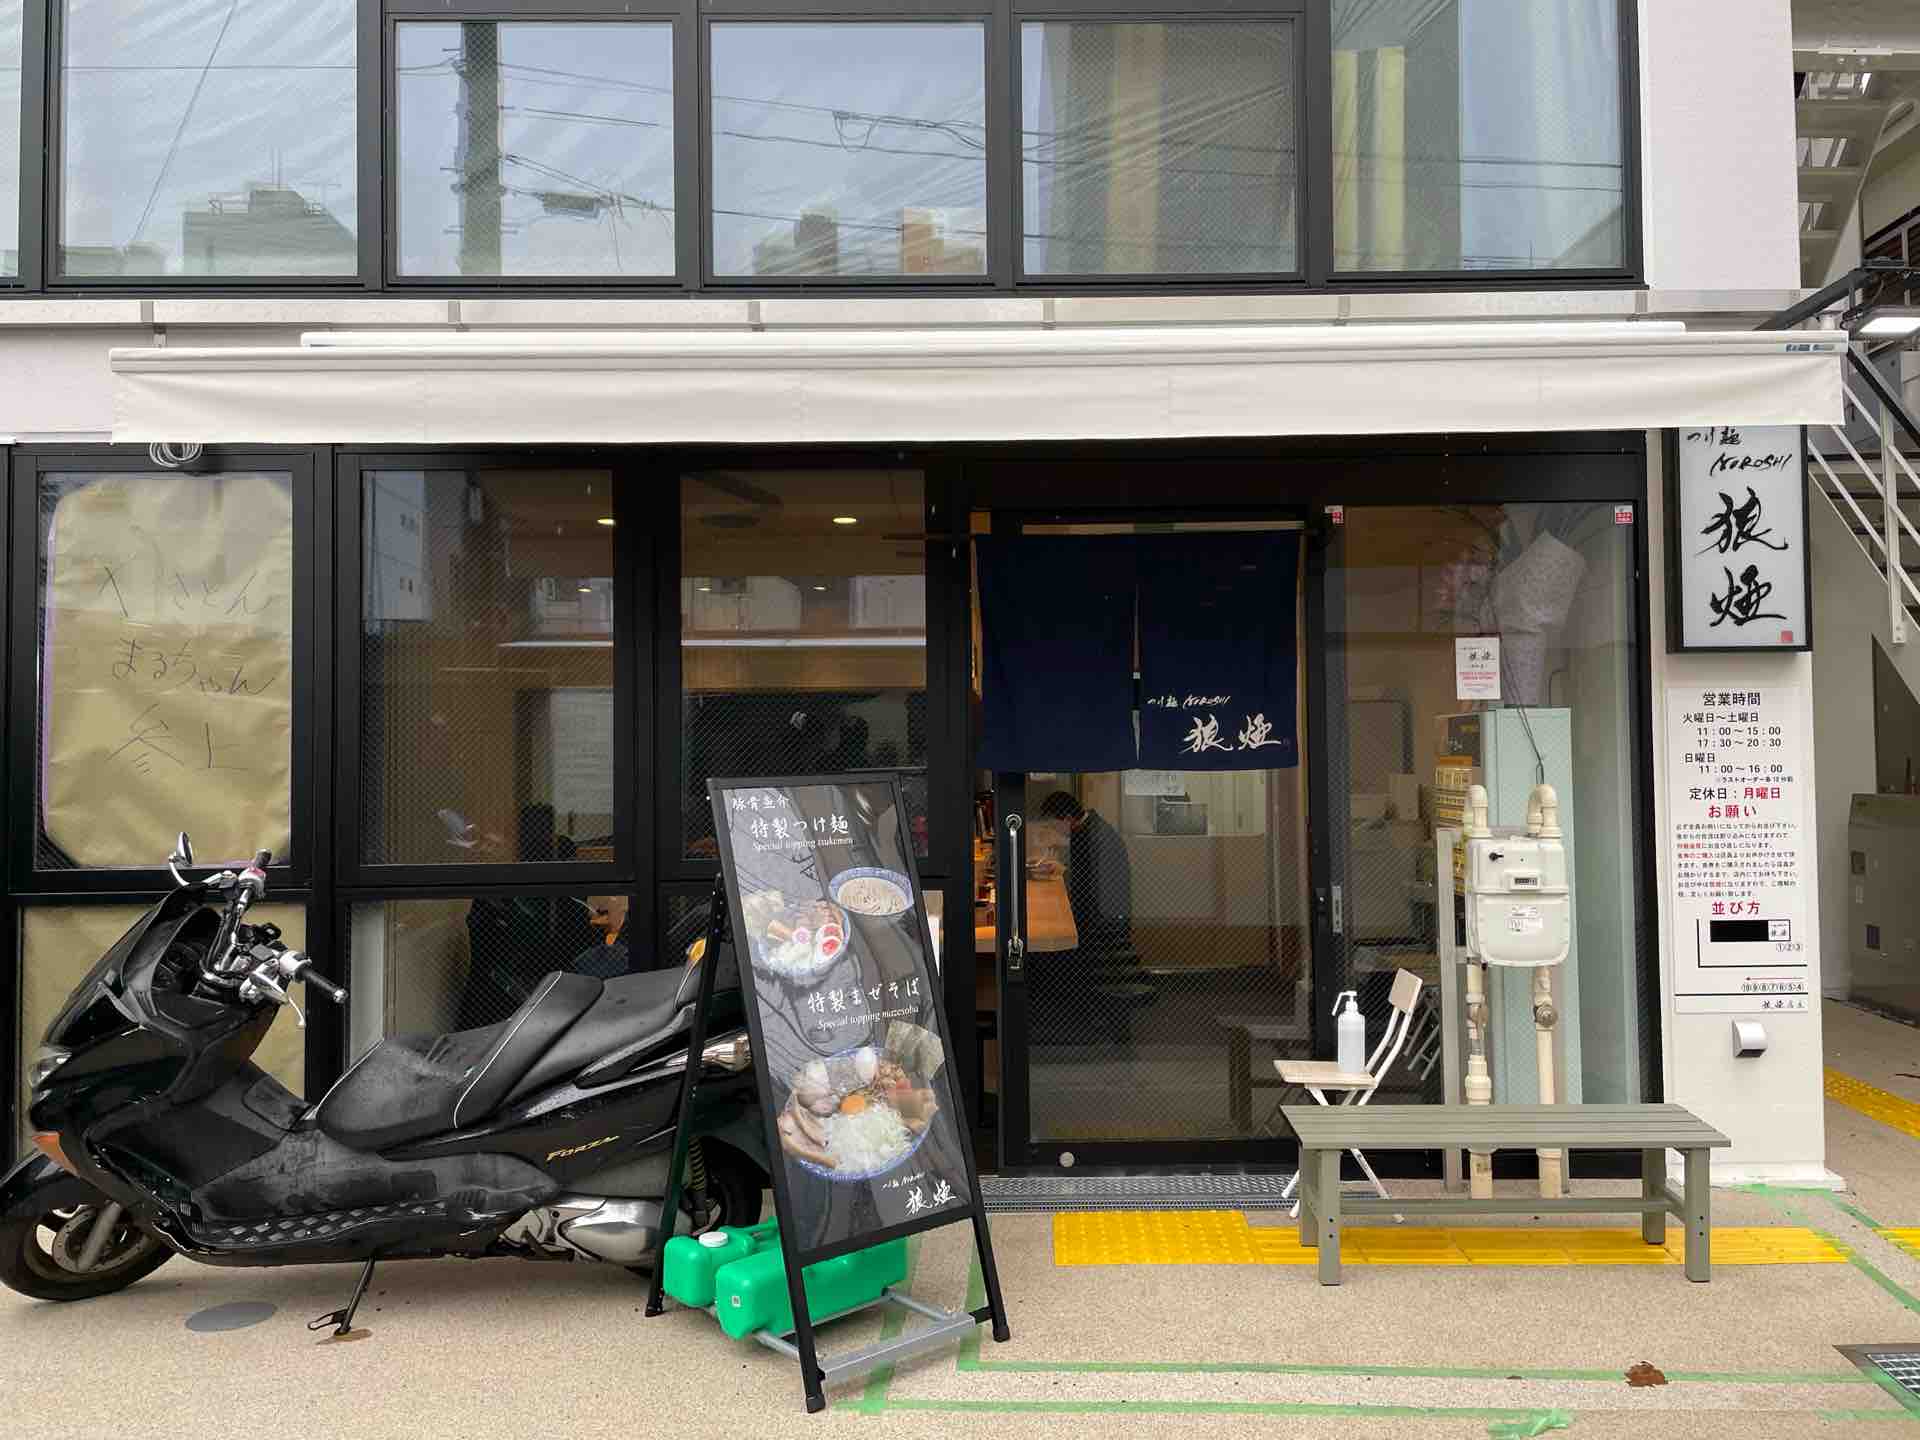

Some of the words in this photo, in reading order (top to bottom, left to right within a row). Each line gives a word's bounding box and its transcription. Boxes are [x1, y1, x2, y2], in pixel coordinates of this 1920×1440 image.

[1702, 692, 1761, 706] 営業時間
[1684, 752, 1715, 763] 日曜日
[1708, 805, 1757, 818] お願い
[751, 814, 849, 839] 特製つけ麺
[1711, 901, 1760, 915] 並び方
[807, 977, 920, 1014] 特製まぜそば
